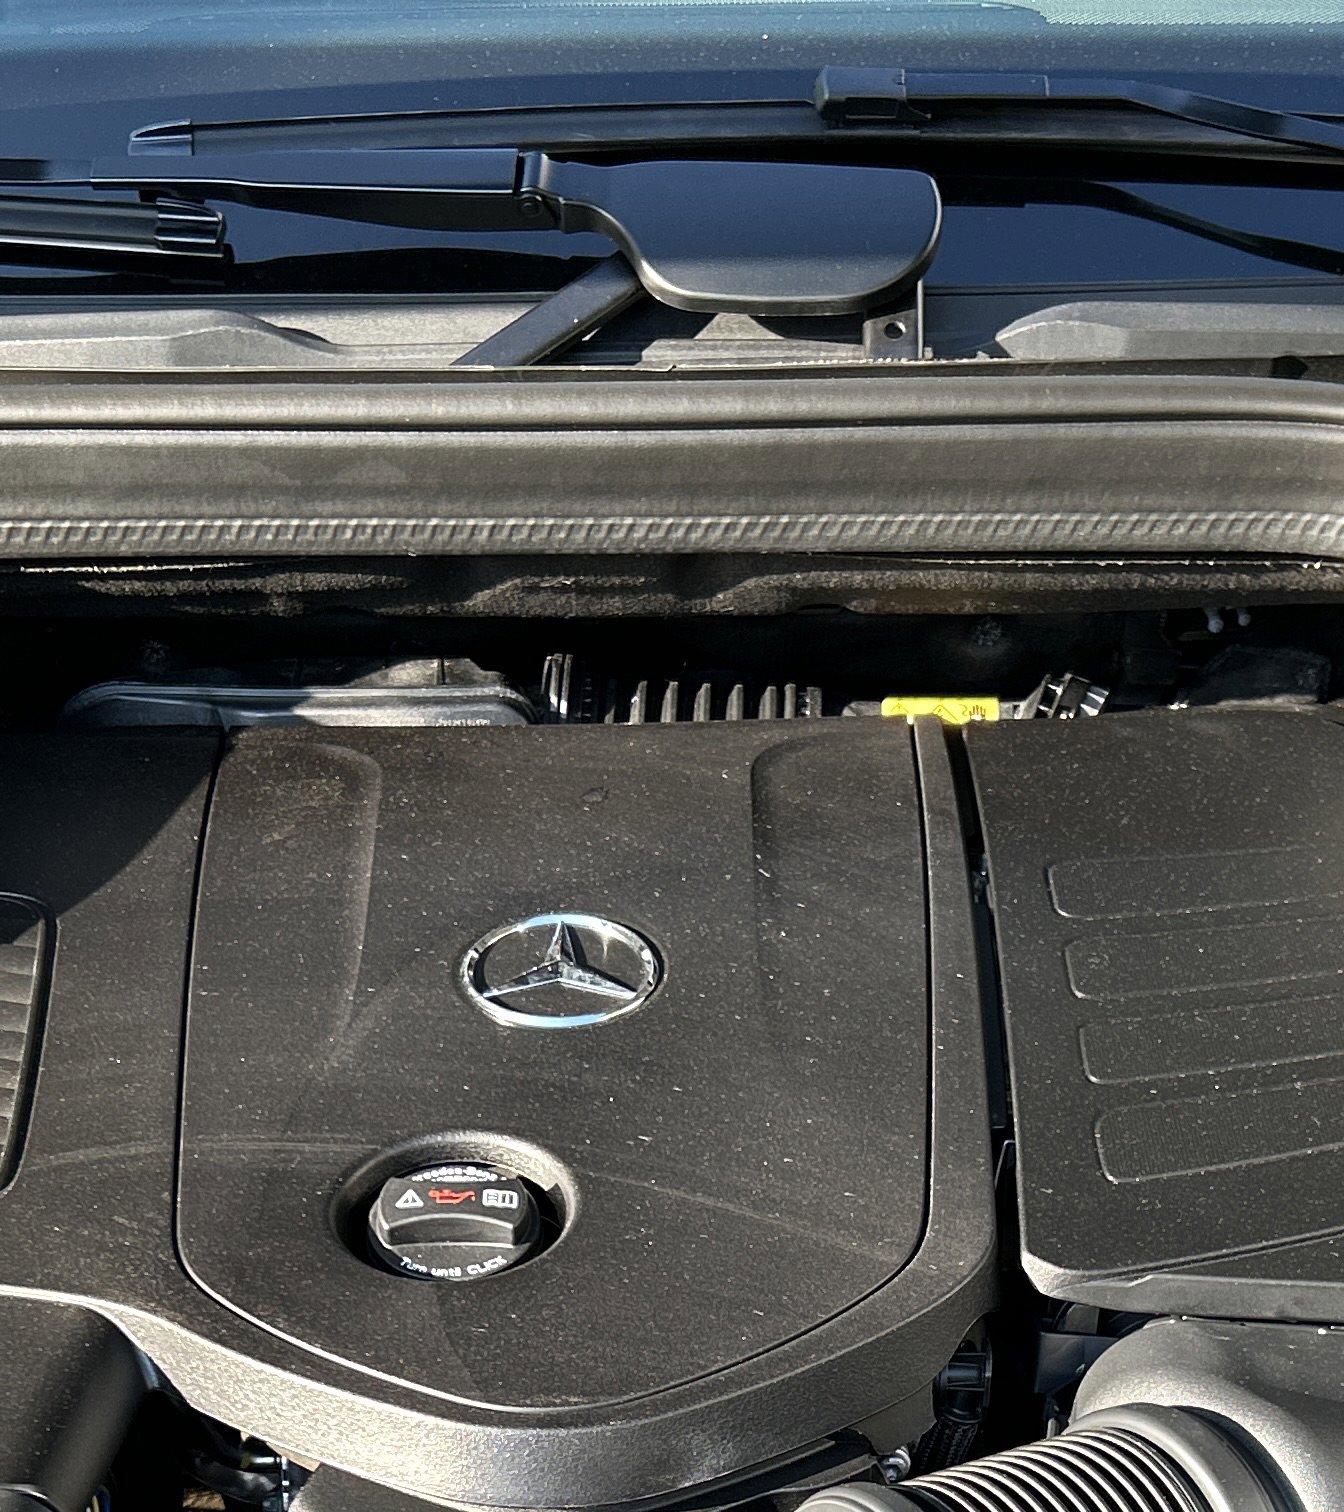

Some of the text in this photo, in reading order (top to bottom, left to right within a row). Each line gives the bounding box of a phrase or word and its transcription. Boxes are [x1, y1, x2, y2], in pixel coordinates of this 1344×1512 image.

[400, 1255, 508, 1277] Turn until CLICK
